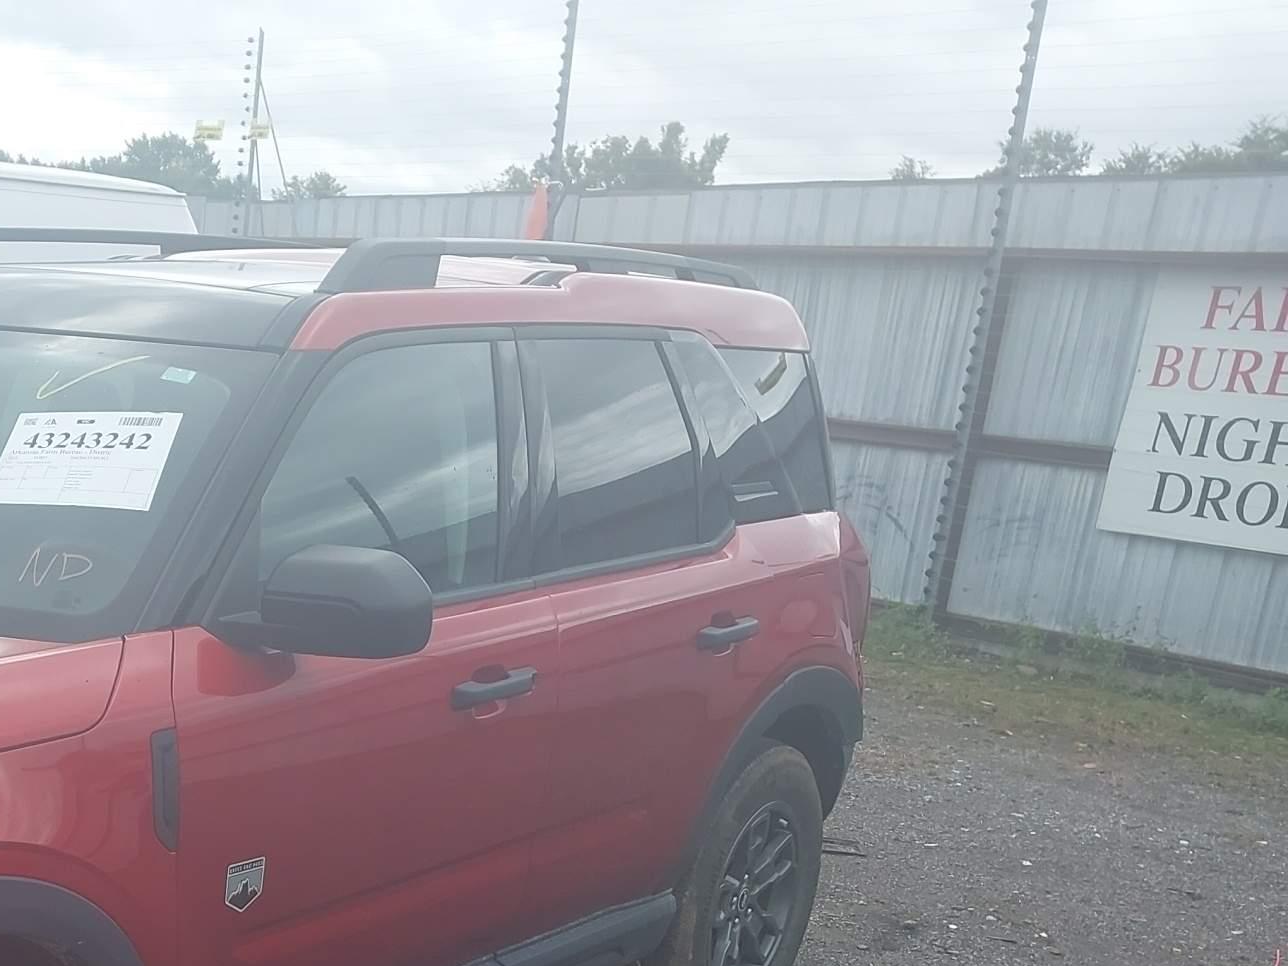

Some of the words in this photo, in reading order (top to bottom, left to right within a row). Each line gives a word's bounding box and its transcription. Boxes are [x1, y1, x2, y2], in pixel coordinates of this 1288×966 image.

[23, 432, 153, 450] 43243242
[1147, 470, 1288, 530] DRO
[18, 547, 93, 586] ND
